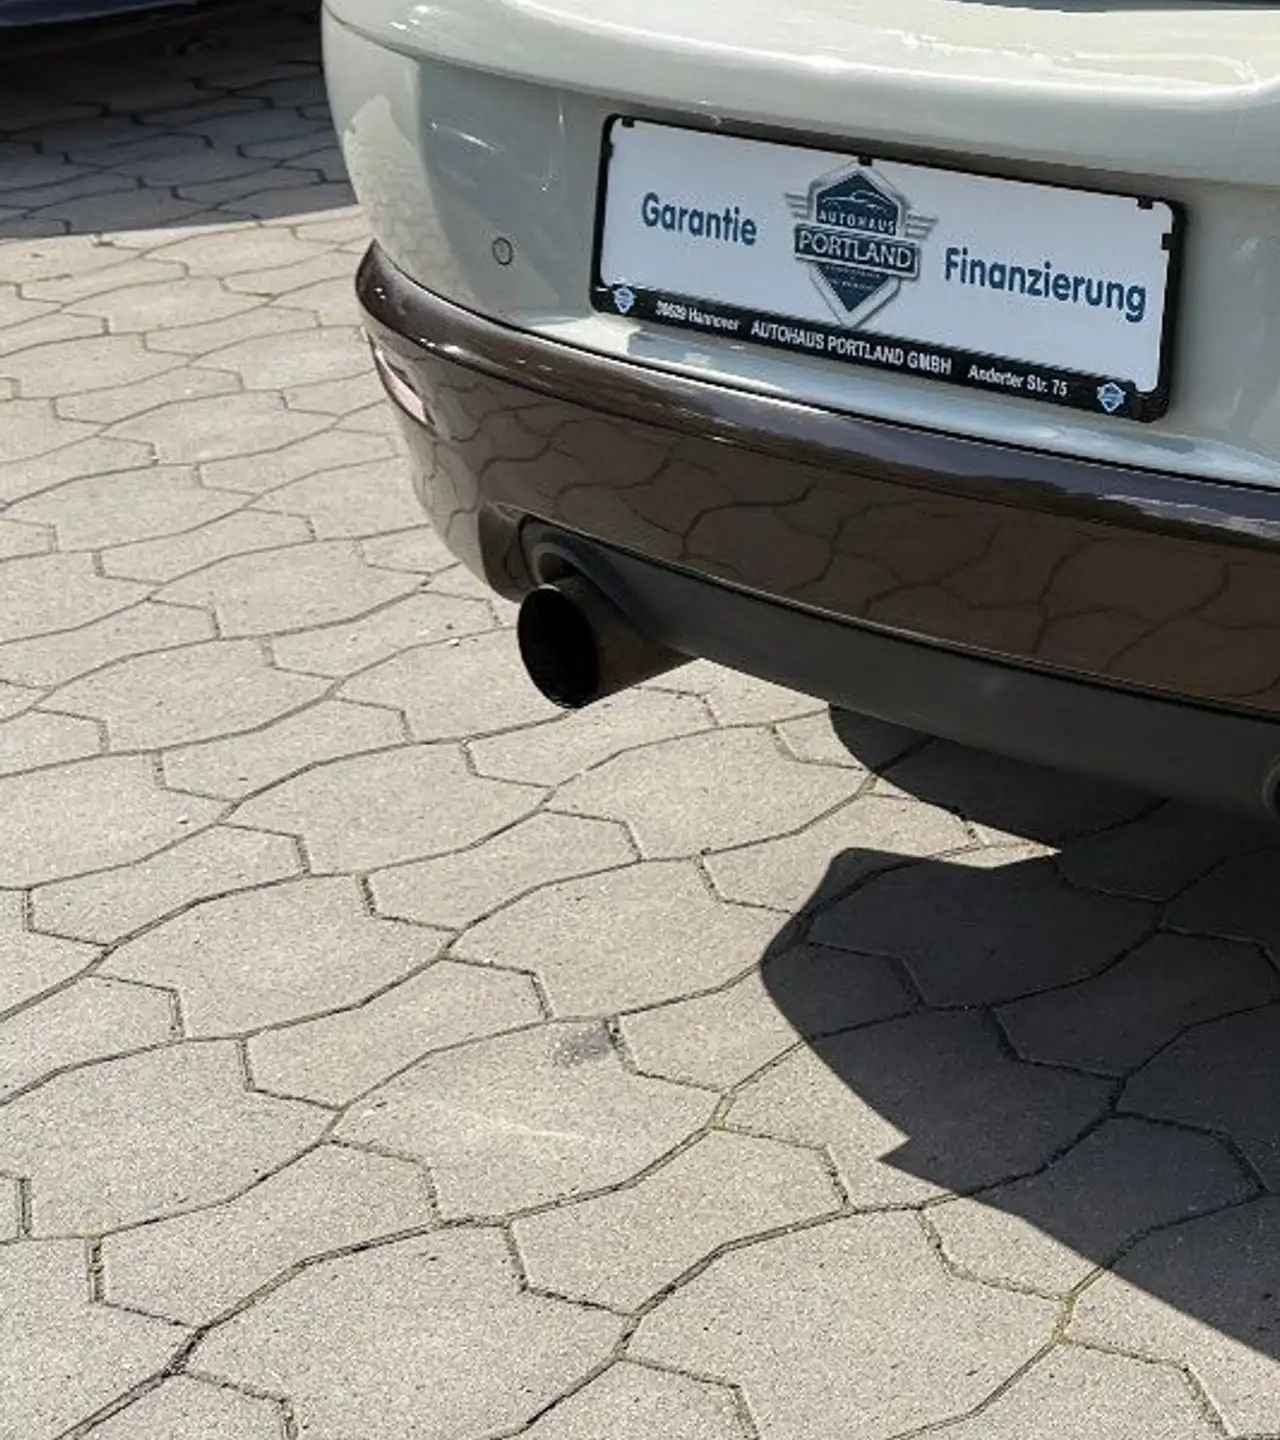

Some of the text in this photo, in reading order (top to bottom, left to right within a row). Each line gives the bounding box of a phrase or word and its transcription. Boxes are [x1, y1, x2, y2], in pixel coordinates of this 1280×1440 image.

[641, 191, 758, 246] Garantie
[818, 210, 896, 234] AUTOHAUS
[798, 229, 912, 268] PORTLAND
[944, 247, 1147, 323] Finanzierung
[688, 307, 740, 332] Hannover
[751, 319, 825, 351] AUTOHAUS
[827, 334, 904, 367] PORTLAND
[906, 352, 952, 376] GMBH
[1052, 378, 1069, 397] 75
